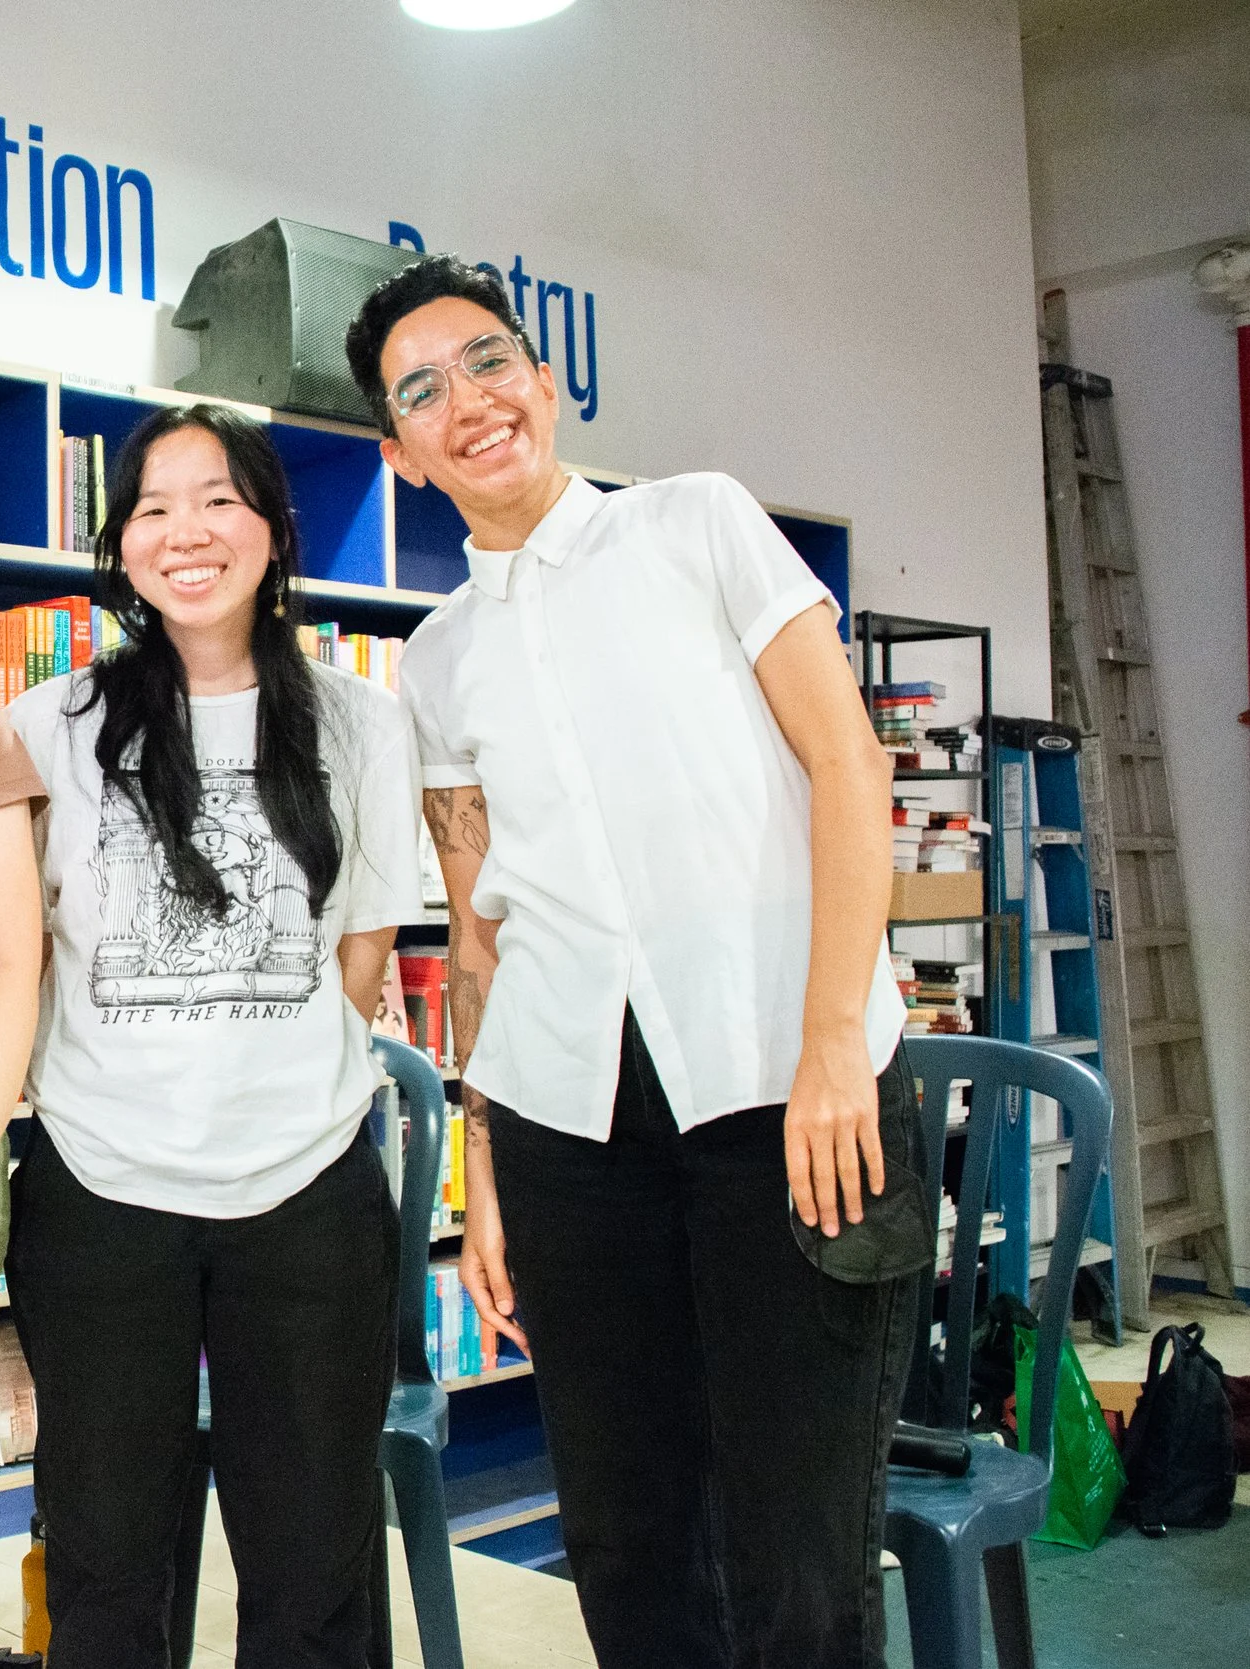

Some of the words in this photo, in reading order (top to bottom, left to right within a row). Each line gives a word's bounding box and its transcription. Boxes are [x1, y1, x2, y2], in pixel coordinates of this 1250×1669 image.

[205, 757, 245, 767] DOES
[101, 1008, 156, 1026] BITE
[169, 1006, 217, 1022] THE
[228, 1004, 303, 1020] HAND!
